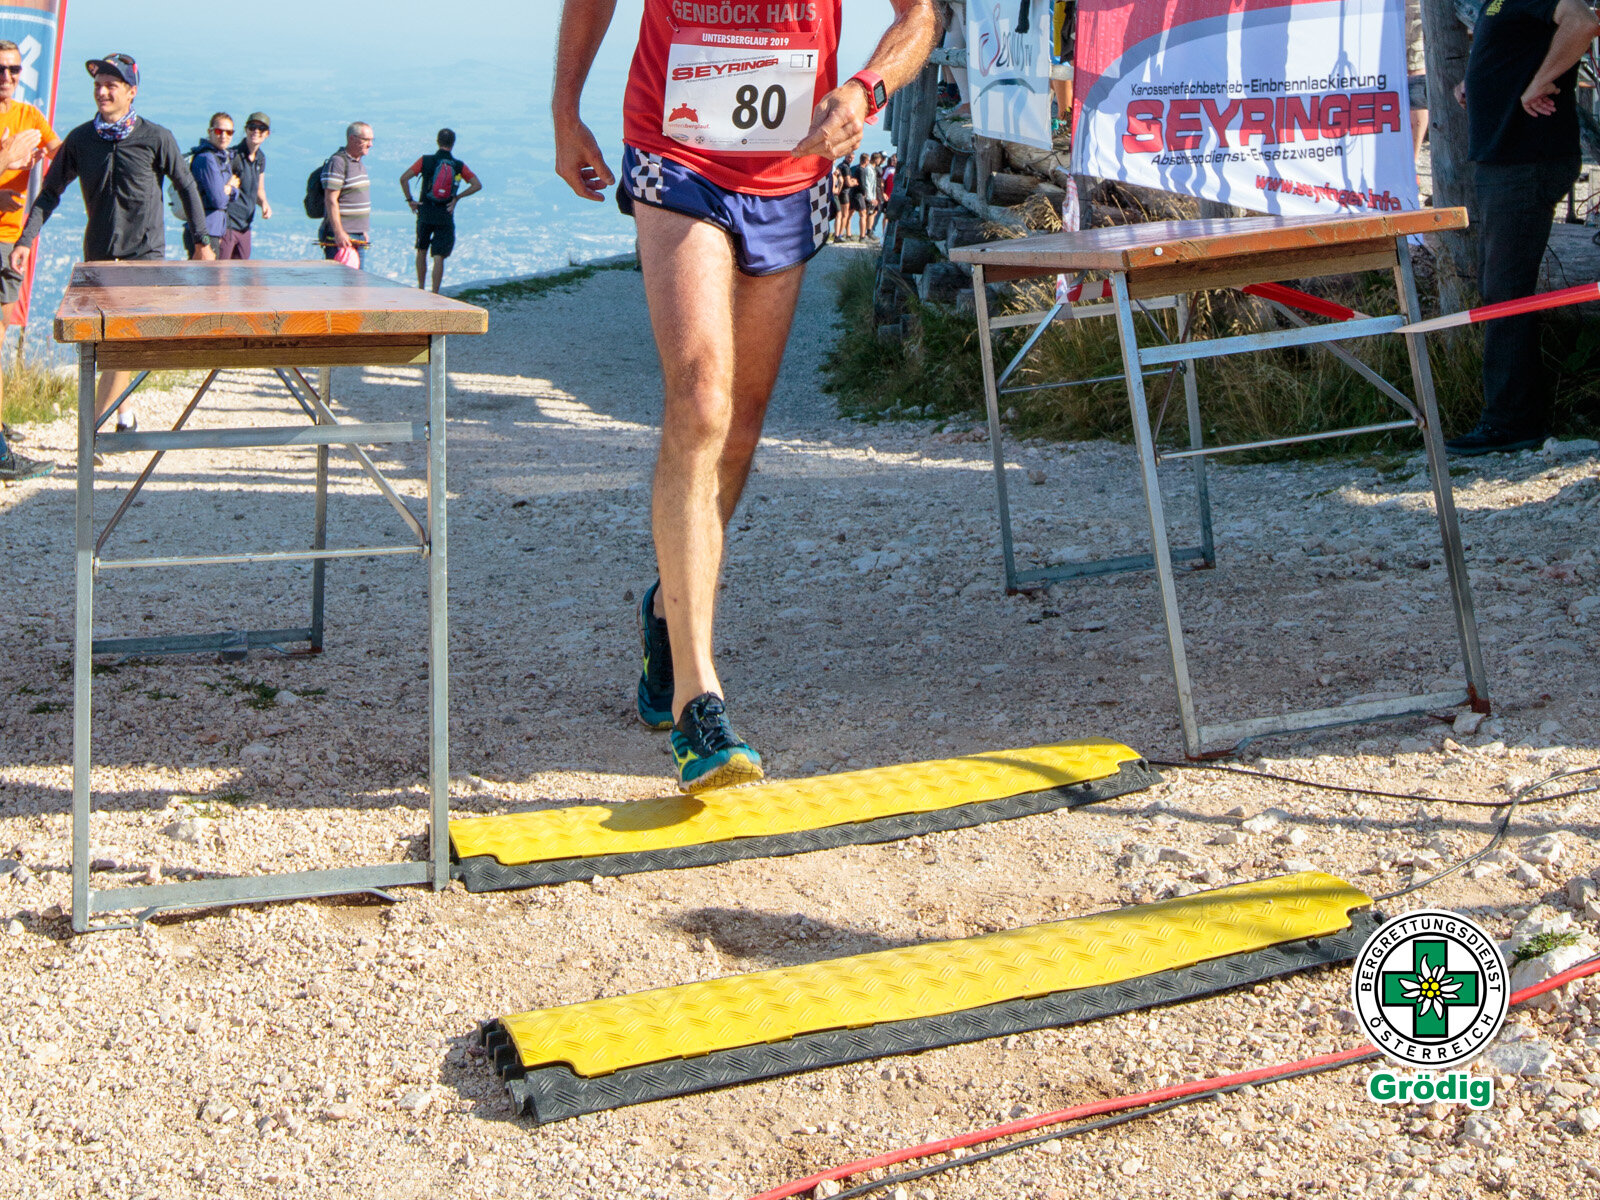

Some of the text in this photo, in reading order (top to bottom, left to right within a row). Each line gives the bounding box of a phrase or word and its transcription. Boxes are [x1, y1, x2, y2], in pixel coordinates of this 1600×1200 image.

[672, 0, 816, 25] GENBÖCK HAUS
[702, 33, 790, 46] UNTERSBERGLAUF 2019
[671, 58, 779, 81] SEYRINGER
[806, 54, 814, 68] T
[731, 84, 787, 130] 80
[1122, 91, 1401, 154] SEYRINGER
